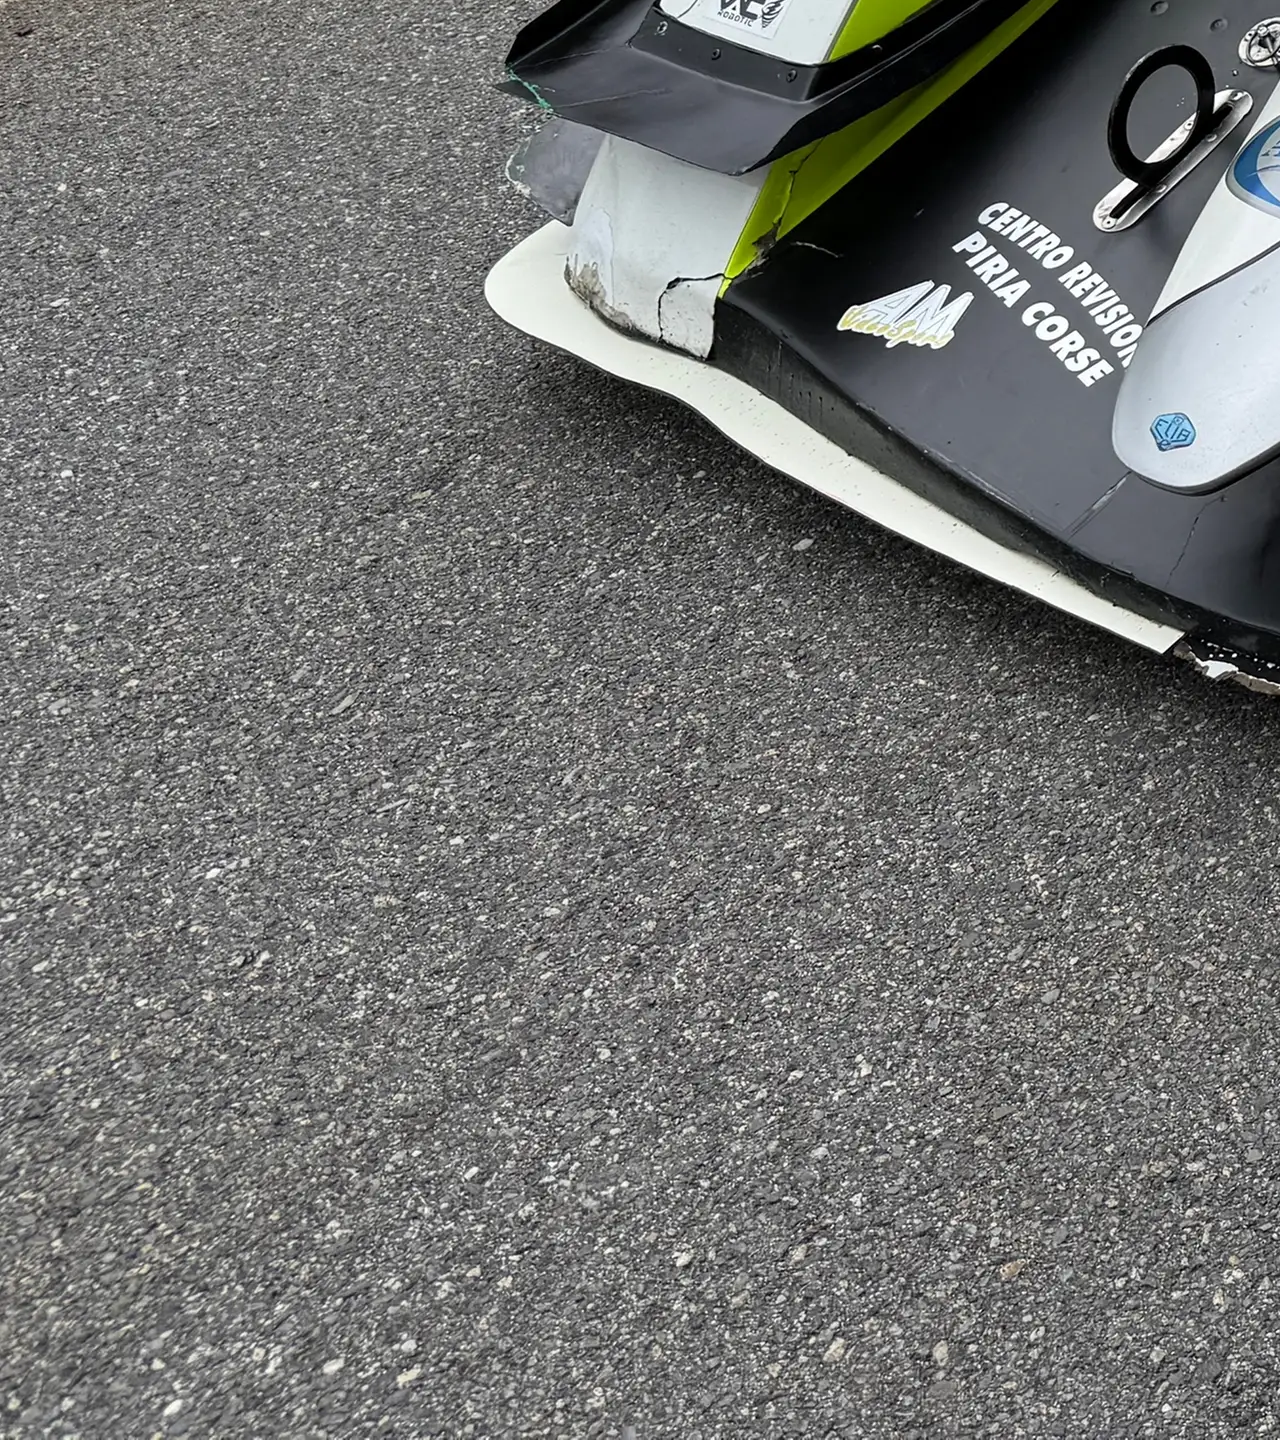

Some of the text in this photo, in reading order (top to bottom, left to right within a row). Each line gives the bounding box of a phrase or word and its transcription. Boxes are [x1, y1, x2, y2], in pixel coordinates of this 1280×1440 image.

[716, 9, 754, 28] ROBOTIC
[976, 201, 1075, 270] CENTRO
[855, 279, 975, 343] AM
[951, 230, 1115, 388] PIRIA CORSE
